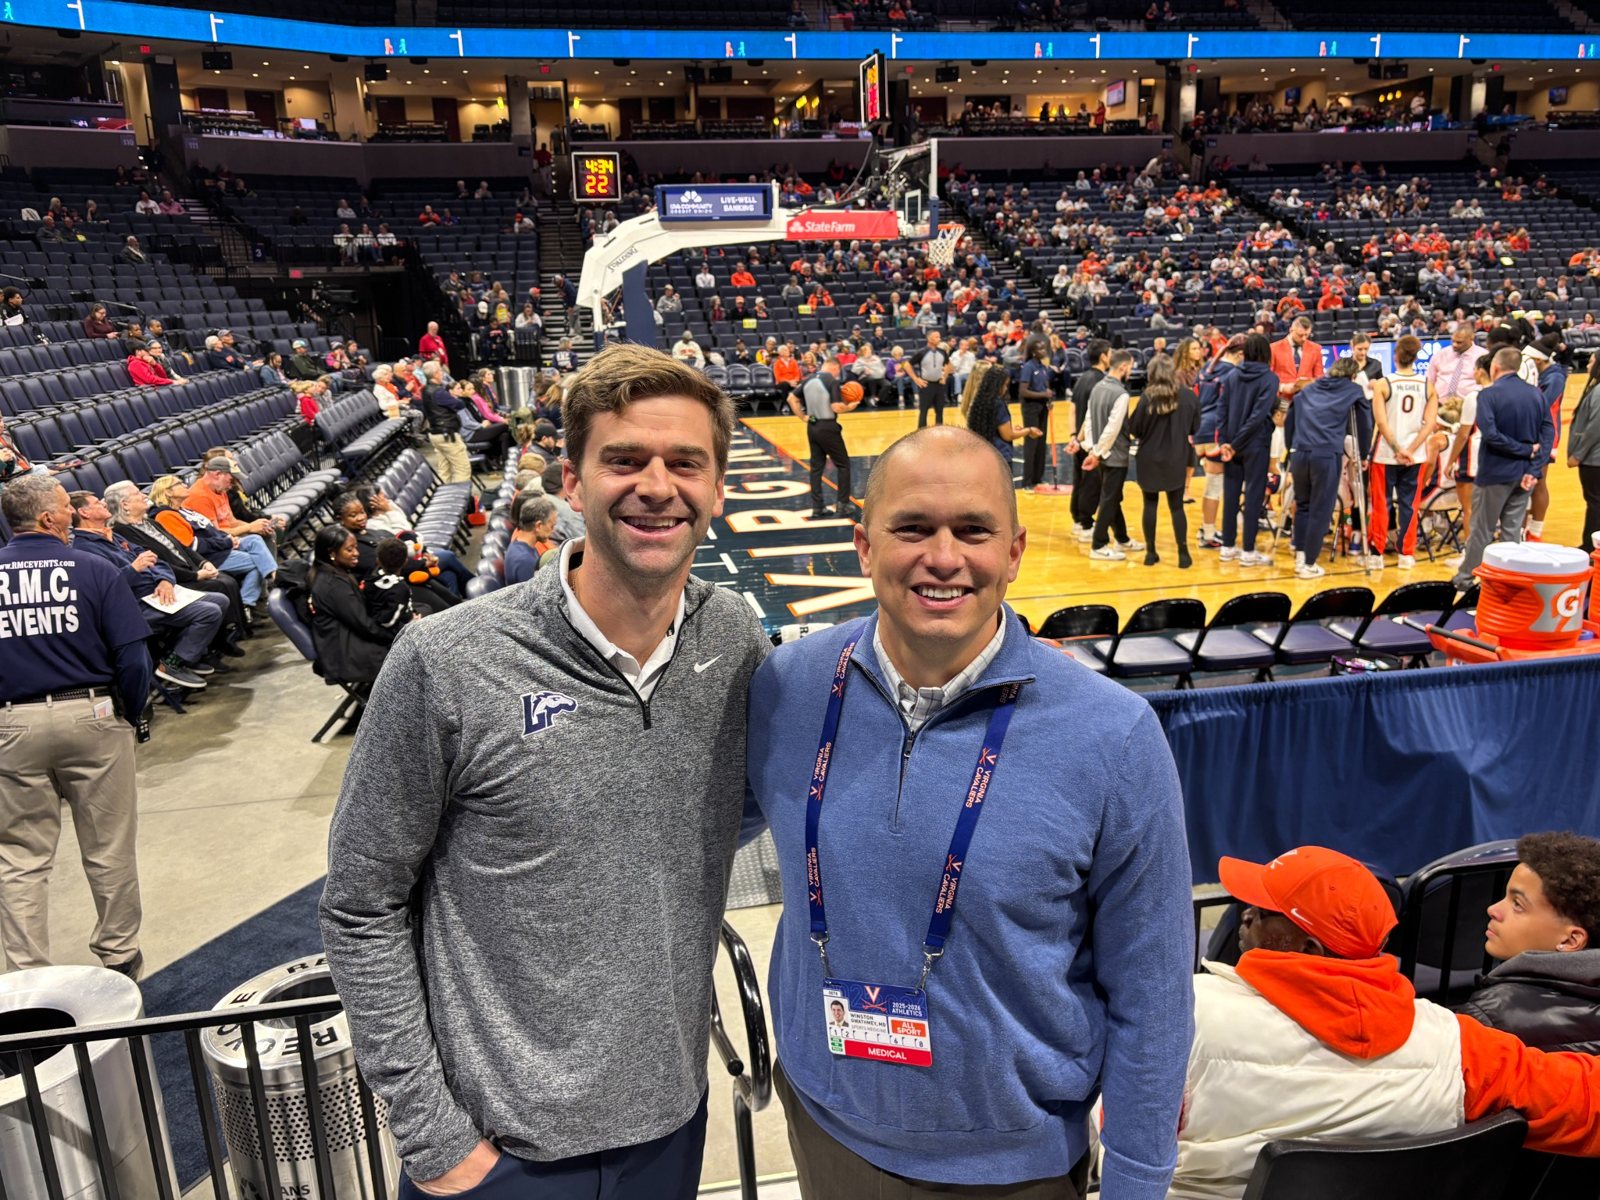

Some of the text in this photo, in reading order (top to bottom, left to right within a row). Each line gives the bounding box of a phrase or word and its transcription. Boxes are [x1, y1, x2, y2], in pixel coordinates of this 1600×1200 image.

[585, 159, 614, 174] 4:34
[585, 174, 609, 194] 22
[723, 204, 755, 212] BANKING
[1402, 394, 1414, 413] 0
[0, 567, 77, 605] R.M.C.
[1556, 588, 1580, 618] G
[0, 605, 79, 639] EVENTS
[835, 647, 848, 678] VIRGINIA
[813, 747, 825, 780] VIRGINIA
[818, 741, 832, 782] CAVALIERS
[965, 766, 984, 808] CAVALIERS
[974, 770, 992, 804] VIRGINIA
[811, 847, 820, 887] CAVALIERS
[935, 873, 951, 914] CAVALIERS
[944, 877, 959, 909] VIRGINIA
[850, 1013, 874, 1021] WINSTON
[891, 1008, 923, 1017] ATHLETICS
[896, 1027, 922, 1036] SPORT
[867, 1047, 907, 1060] MEDICAL
